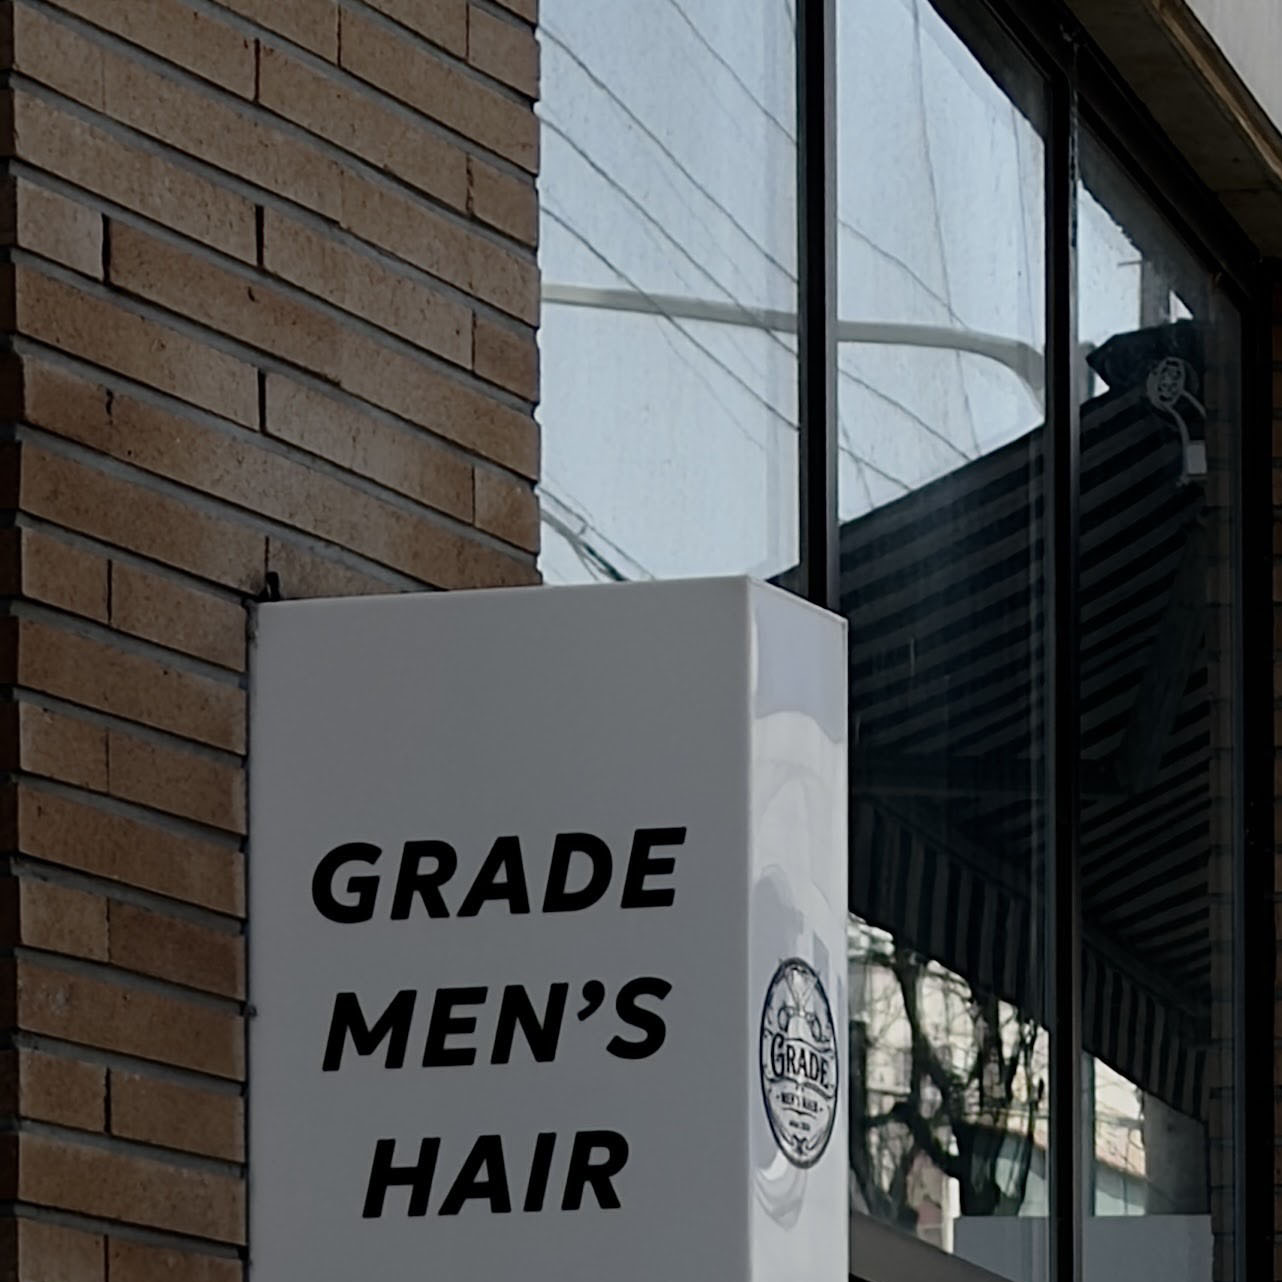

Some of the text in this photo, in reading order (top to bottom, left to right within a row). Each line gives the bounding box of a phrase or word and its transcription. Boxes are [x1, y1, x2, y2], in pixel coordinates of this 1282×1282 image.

[311, 826, 687, 925] GRADE
[321, 976, 673, 1072] MEN'S
[770, 1032, 830, 1090] GRADE
[361, 1129, 629, 1219] HAIR
